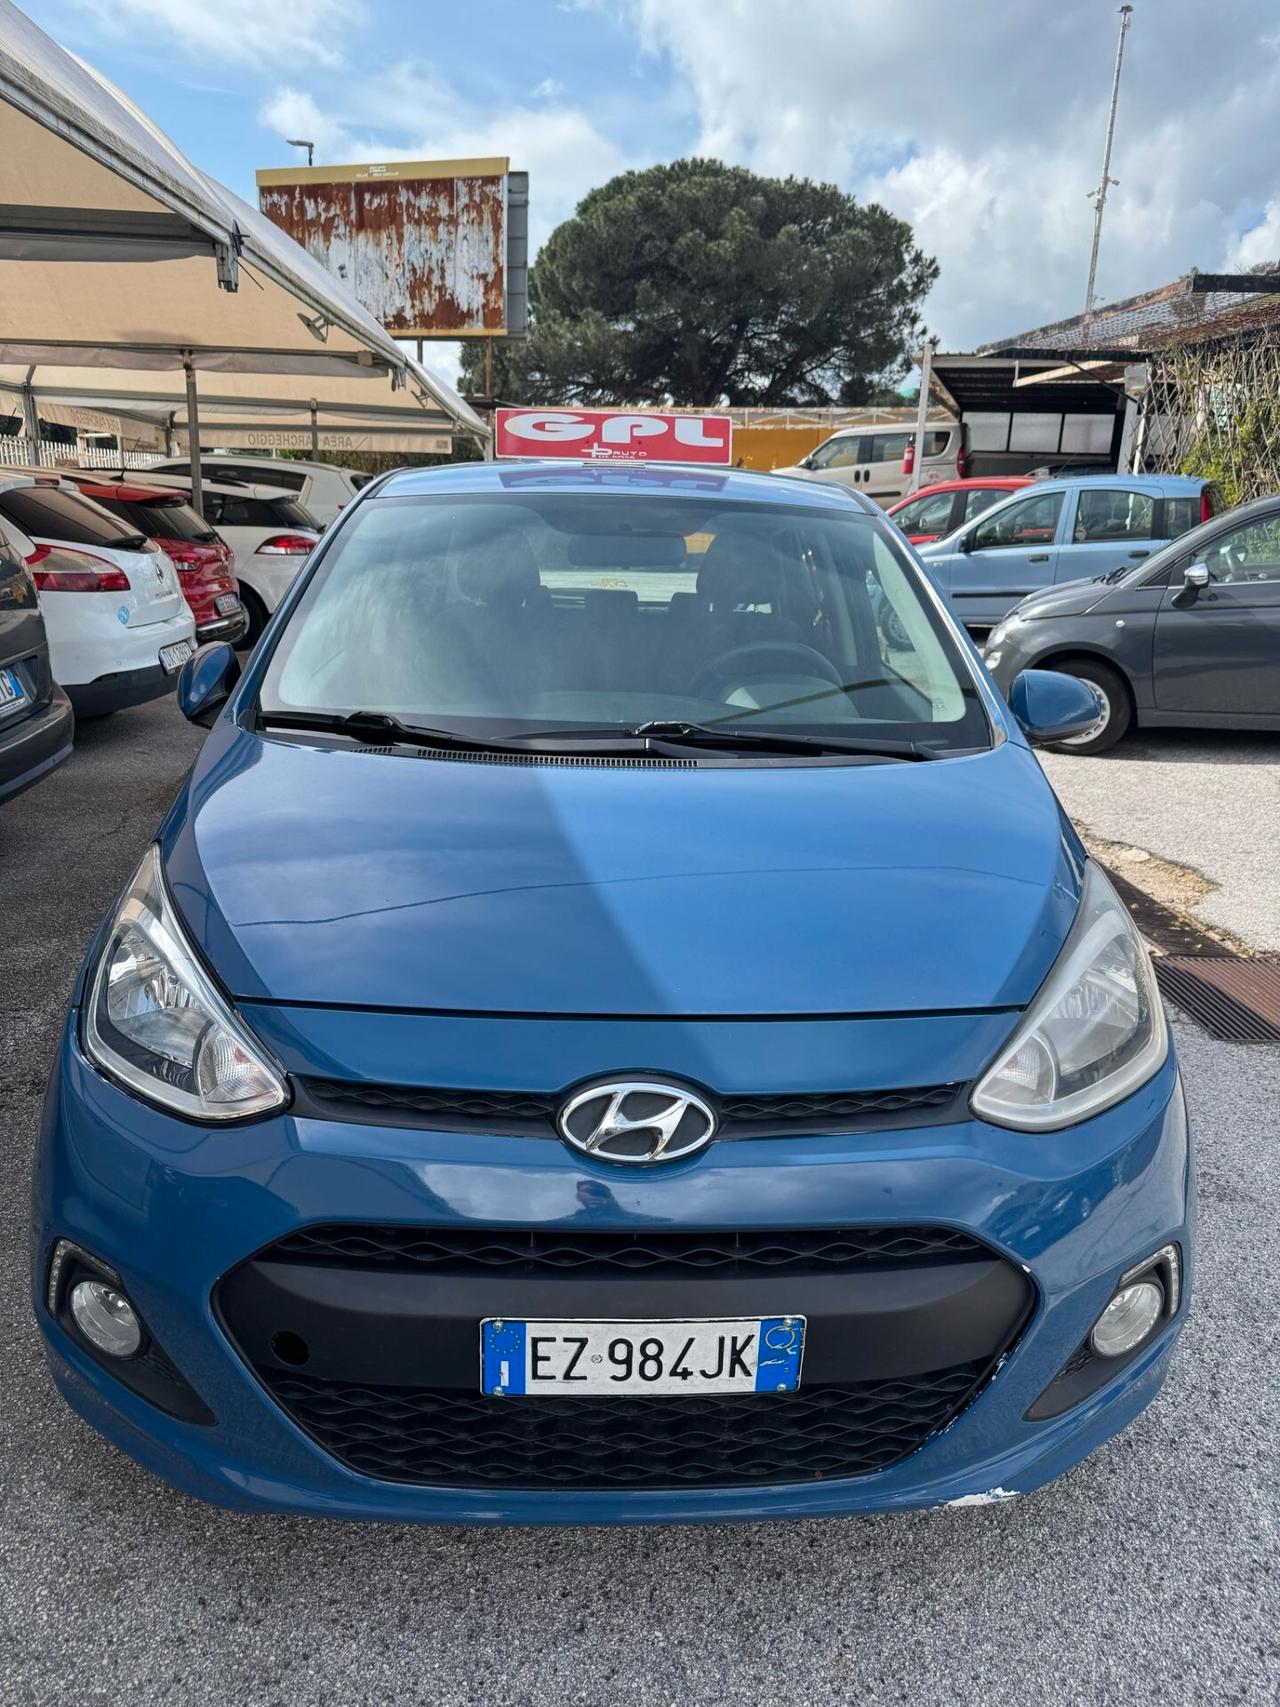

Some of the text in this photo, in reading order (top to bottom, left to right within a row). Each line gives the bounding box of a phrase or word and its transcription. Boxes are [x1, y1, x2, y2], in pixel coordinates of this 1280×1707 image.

[503, 412, 724, 448] GPL
[530, 1333, 756, 1382] EZ 984JK
